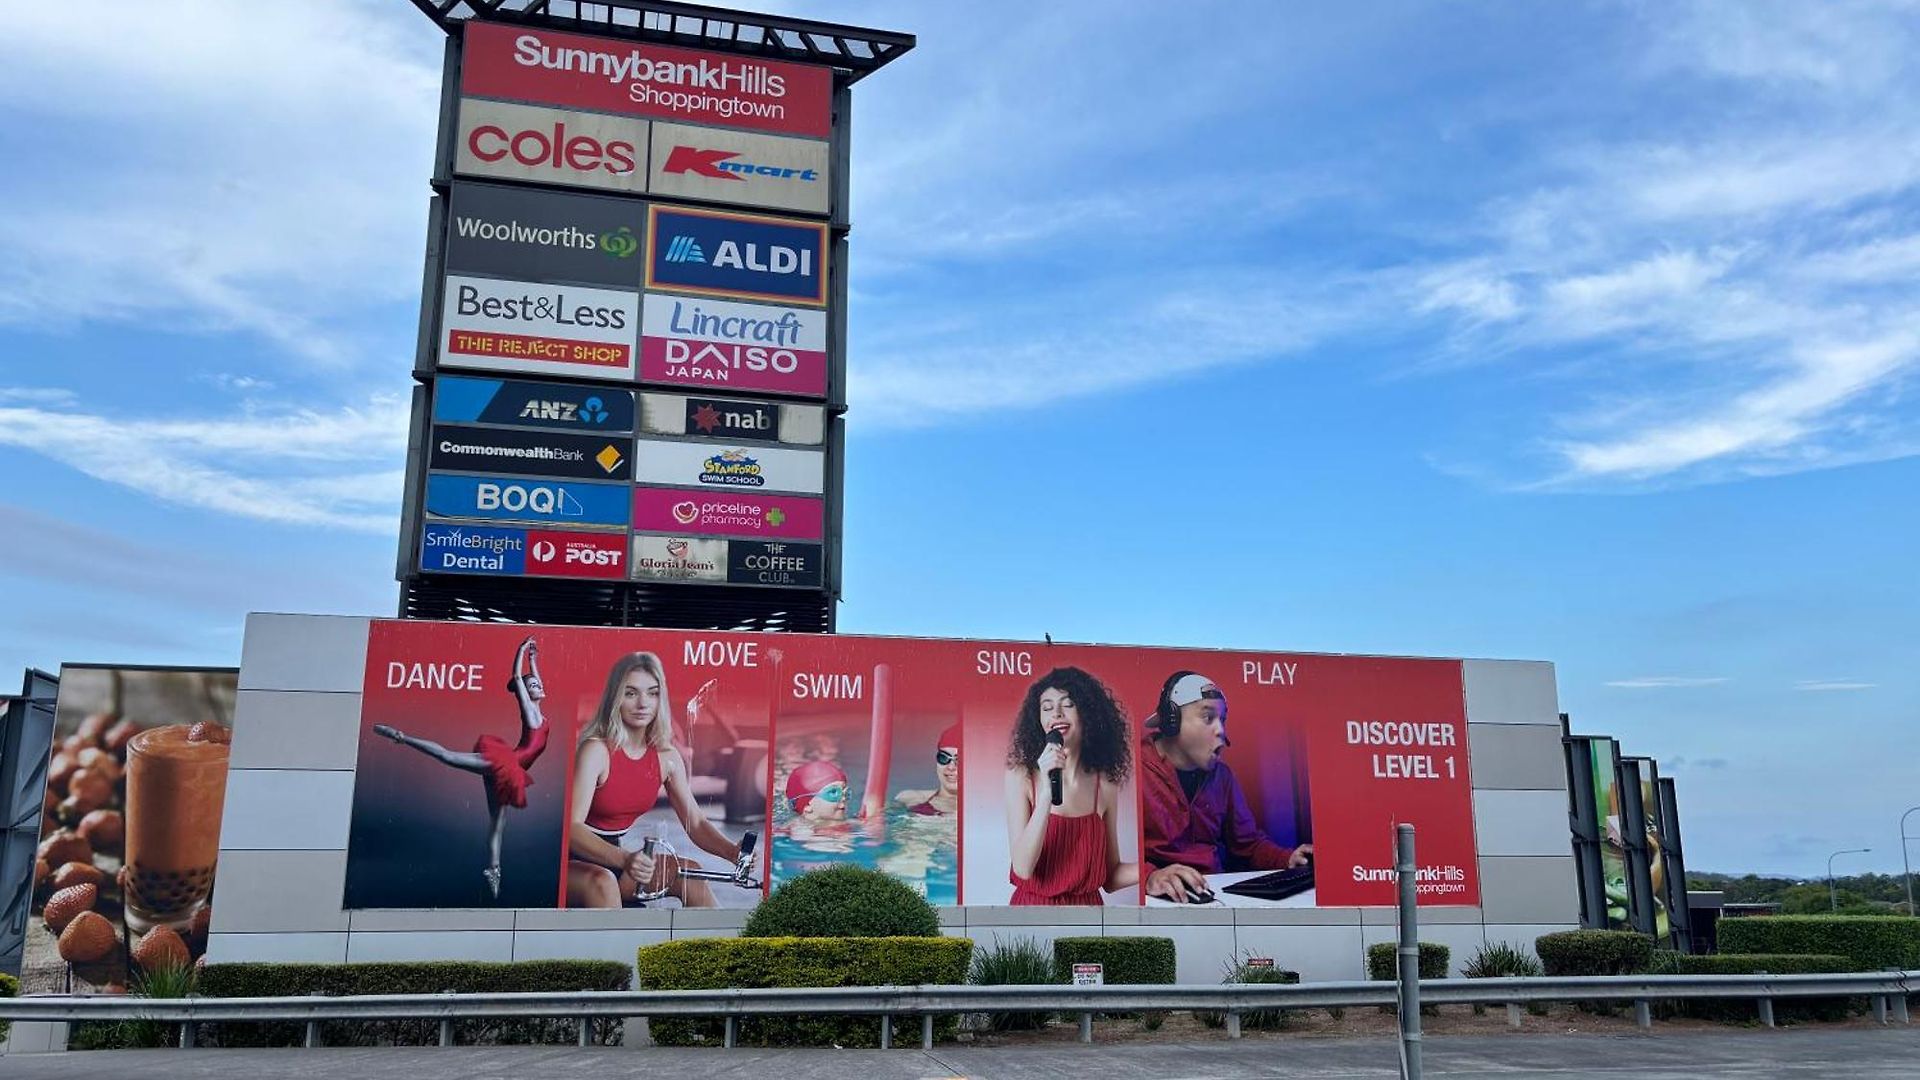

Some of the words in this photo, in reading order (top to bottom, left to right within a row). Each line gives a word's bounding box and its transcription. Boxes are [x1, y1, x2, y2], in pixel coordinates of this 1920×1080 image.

[514, 35, 785, 97] SunnybankHills
[629, 83, 784, 120] Shoppingtown
[468, 122, 636, 177] coles
[456, 217, 596, 250] Woolworths
[712, 241, 811, 276] ALDI
[457, 285, 626, 330] Best&Less
[670, 301, 803, 346] Lincraft
[457, 335, 493, 352] THE
[499, 339, 569, 358] REJECT
[574, 345, 622, 362] SHOP
[665, 340, 798, 374] DAISO
[665, 365, 729, 381] JAPAN
[519, 399, 578, 421] ANZ
[725, 409, 771, 430] nab
[439, 441, 584, 461] CommonwealthBank
[702, 474, 724, 482] SWIM
[726, 475, 761, 485] SCHOOL
[477, 483, 555, 514] BOQ
[702, 502, 761, 515] priceline
[702, 513, 761, 529] pharmacy
[426, 529, 522, 555] SmileBright
[764, 543, 787, 555] THE
[443, 553, 504, 570] Dental
[565, 549, 622, 566] POST
[640, 557, 679, 569] Gloria
[745, 555, 805, 571] COFFEE
[758, 571, 789, 584] CLUB
[683, 640, 758, 667] MOVE
[976, 650, 1032, 676] SING
[386, 662, 484, 691] DANCE
[793, 673, 863, 699] SWIM
[1243, 661, 1298, 686] PLAY
[1346, 721, 1456, 746] DISCOVER
[1373, 754, 1440, 778] LEVEL
[1445, 756, 1455, 778] 1
[1352, 865, 1465, 885] SunnynkHills
[1415, 883, 1465, 894] ppingtown
